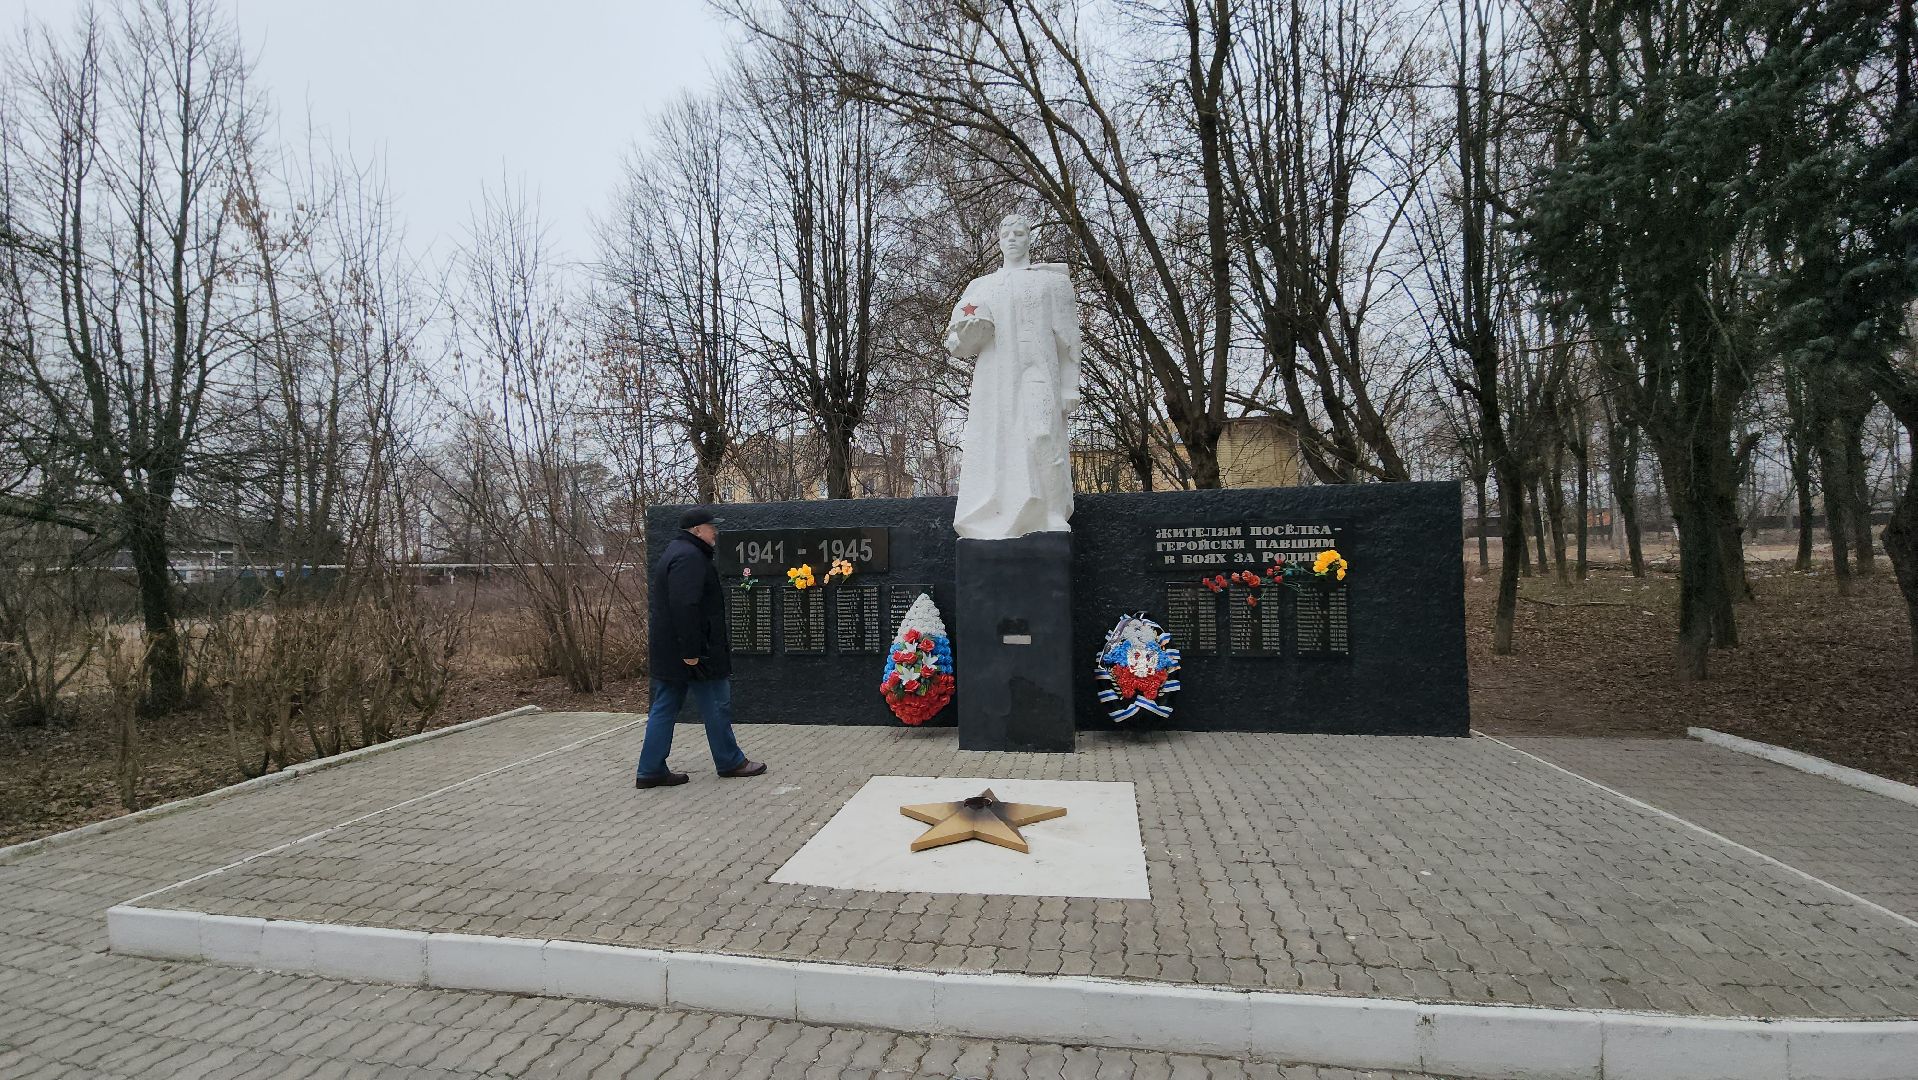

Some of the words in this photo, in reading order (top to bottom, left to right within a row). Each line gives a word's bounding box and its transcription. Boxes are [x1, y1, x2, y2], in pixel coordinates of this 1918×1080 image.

[1155, 526, 1242, 539] ЖИТЕЛЯМ
[735, 540, 785, 564] 1941
[818, 538, 873, 563] 1945
[1156, 538, 1245, 552] ГЕРОЙСКИ
[1255, 538, 1336, 549] ПАВШИМ
[1182, 553, 1227, 564] БОЯХ
[1233, 552, 1255, 563] ЗА
